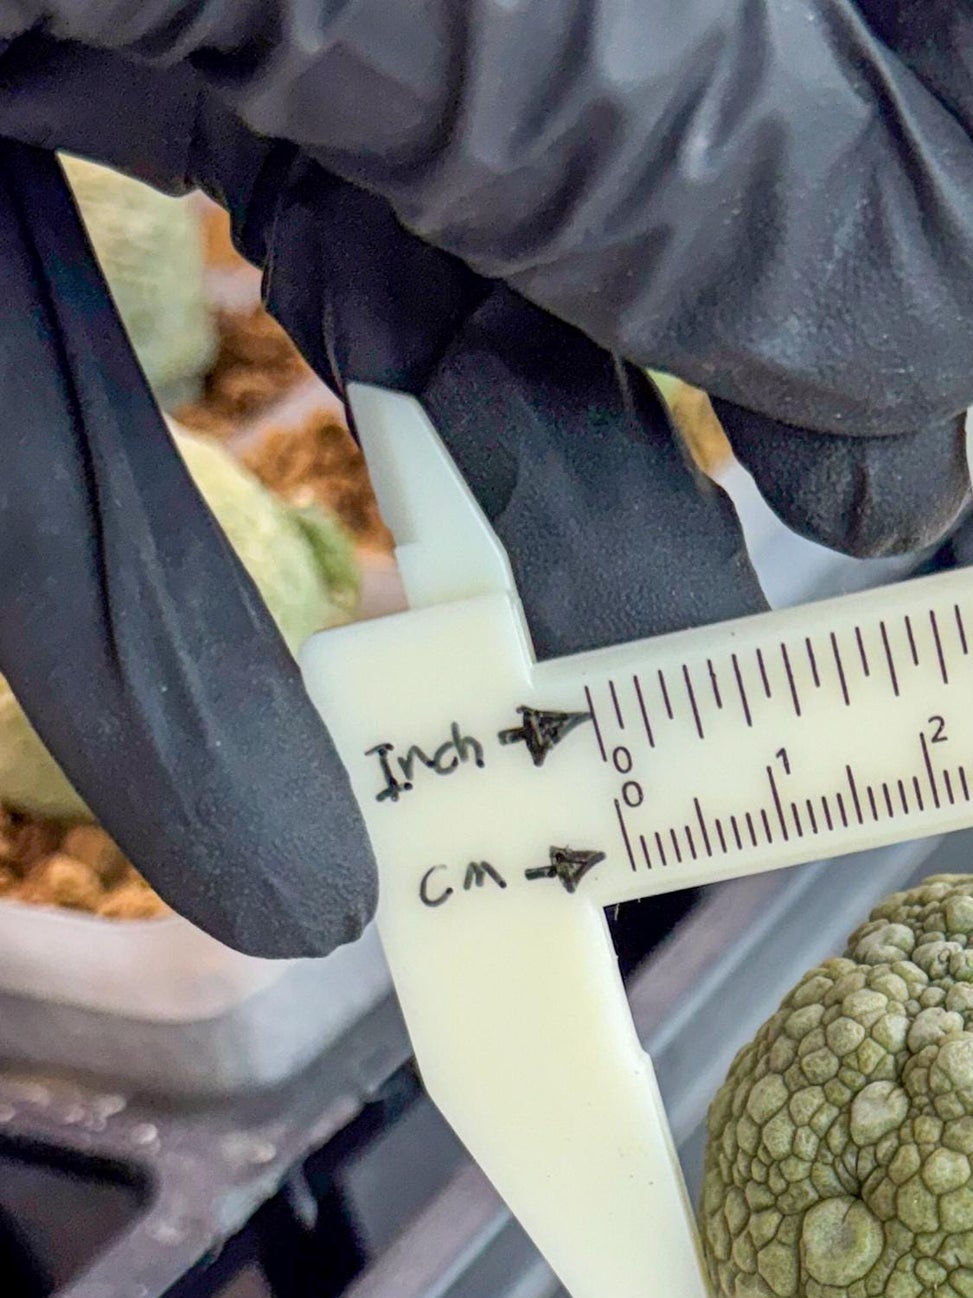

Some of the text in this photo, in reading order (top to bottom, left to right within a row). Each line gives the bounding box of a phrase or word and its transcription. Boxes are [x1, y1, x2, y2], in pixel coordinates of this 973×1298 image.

[364, 721, 486, 803] Inch
[611, 745, 634, 775] 0
[621, 780, 645, 809] 0
[775, 747, 792, 776] 1
[927, 714, 949, 744] 2
